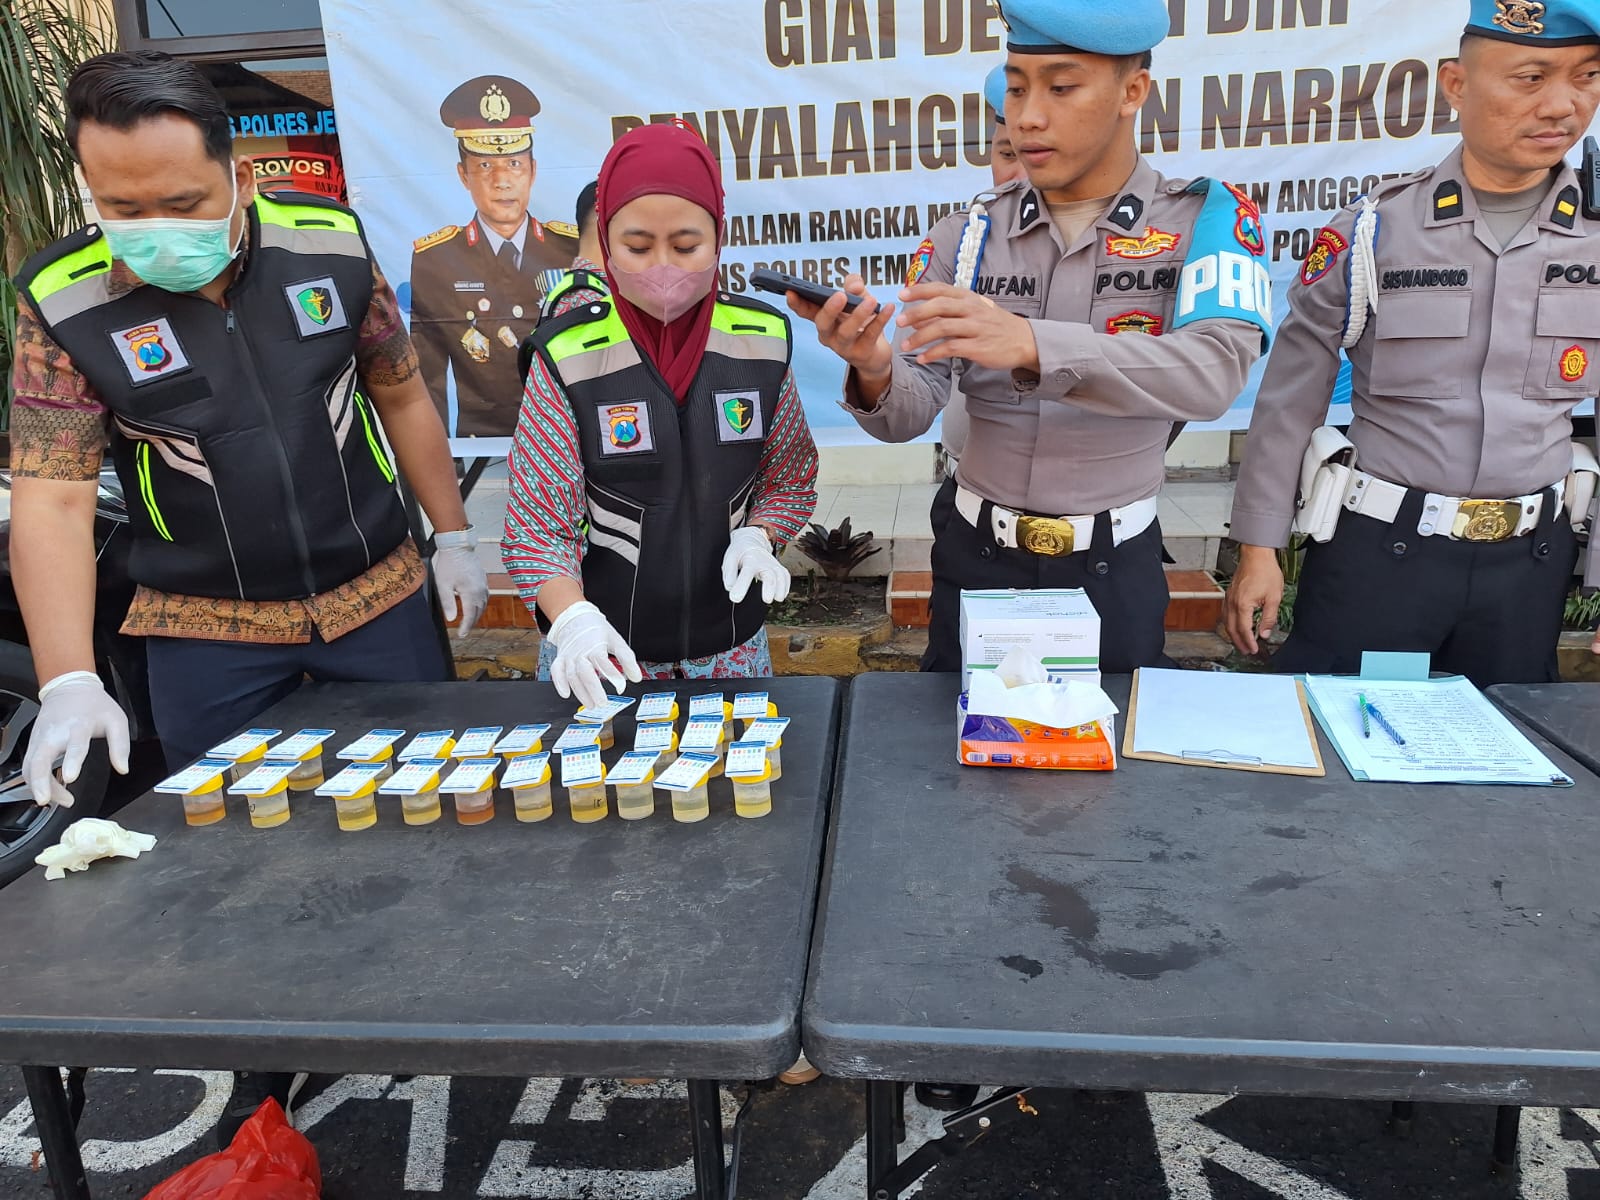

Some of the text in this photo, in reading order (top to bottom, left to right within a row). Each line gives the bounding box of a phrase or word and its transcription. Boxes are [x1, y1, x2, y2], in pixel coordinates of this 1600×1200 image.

[240, 111, 309, 138] POLRES
[809, 205, 921, 243] RANGKA
[1276, 172, 1415, 215] ANGGO
[975, 275, 1036, 297] ULFAN
[1096, 267, 1177, 295] POLRI
[1381, 268, 1469, 290] SISWANDOKO
